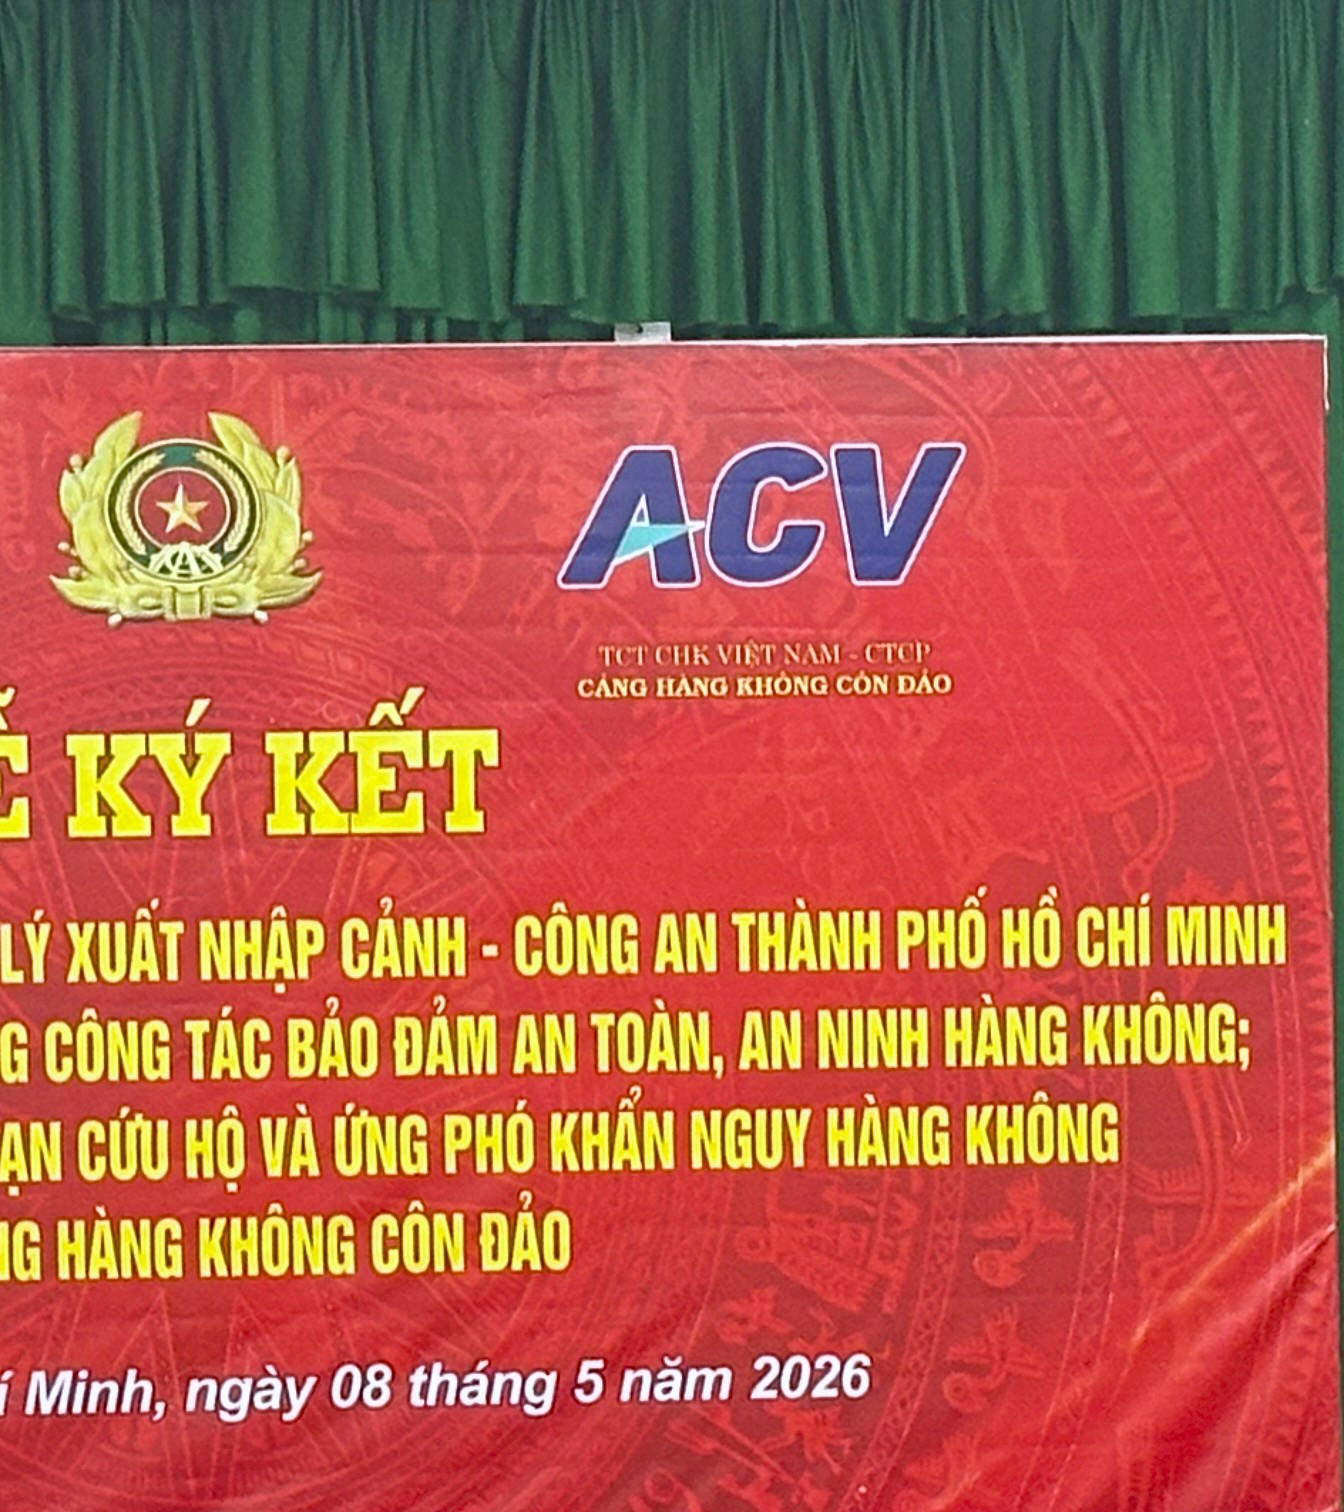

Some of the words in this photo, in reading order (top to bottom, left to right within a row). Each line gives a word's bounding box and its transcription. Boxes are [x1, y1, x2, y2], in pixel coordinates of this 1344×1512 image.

[557, 441, 967, 589] ACV
[577, 671, 647, 699] CẢNG
[655, 671, 729, 698] HÀNG
[735, 670, 828, 696] KHÔNG
[836, 669, 890, 695] CÔN
[896, 669, 952, 695] ĐẢO
[598, 643, 649, 668] TCT
[654, 642, 709, 667] CHK
[716, 637, 776, 669] VIỆT
[784, 643, 841, 665] NAM
[864, 640, 932, 664] CTCP
[66, 698, 232, 838] KÝ
[264, 686, 499, 836] KẾT
[0, 909, 51, 984] LÝ
[66, 897, 185, 984] XUẤT
[199, 905, 325, 994] NHẬP
[341, 896, 466, 980] CẢNH
[482, 944, 499, 957] -
[514, 901, 639, 977] CÔNG
[654, 912, 717, 974] AN
[731, 897, 881, 972] THÀNH
[896, 886, 987, 970] PHỐ
[1001, 885, 1061, 969] HỒ
[1076, 892, 1151, 968] CHÍ
[1166, 904, 1286, 966] MINH
[44, 1007, 171, 1083] CÔNG
[184, 1005, 272, 1080] TÁC
[287, 996, 379, 1078] BẢO
[392, 994, 498, 1077] ĐẢM
[512, 1013, 576, 1074] AN
[590, 998, 724, 1080] TOÀN,
[738, 1009, 802, 1071] AN
[817, 1007, 929, 1069] NINH
[944, 993, 1068, 1068] HÀNG
[1082, 991, 1250, 1071] KHÔNG;
[77, 1106, 169, 1182] CỨU
[185, 1104, 246, 1193] HỘ
[259, 1103, 320, 1178] VÀ
[334, 1102, 428, 1177] ỨNG
[444, 1099, 535, 1174] PHÓ
[550, 1085, 675, 1173] KHẨN
[690, 1107, 812, 1170] NGUY
[826, 1093, 951, 1167] HÀNG
[965, 1090, 1119, 1165] KHÔNG
[57, 1205, 183, 1281] HÀNG
[198, 1202, 356, 1278] KHÔNG
[371, 1199, 465, 1275] CÔN
[479, 1190, 571, 1272] ĐẢO
[25, 1368, 166, 1421] Minh,
[186, 1364, 317, 1423] ngày
[331, 1363, 392, 1409] 08
[409, 1360, 558, 1416] tháng
[574, 1359, 604, 1403] 5
[620, 1356, 733, 1402] năm
[750, 1353, 871, 1399] 2026
